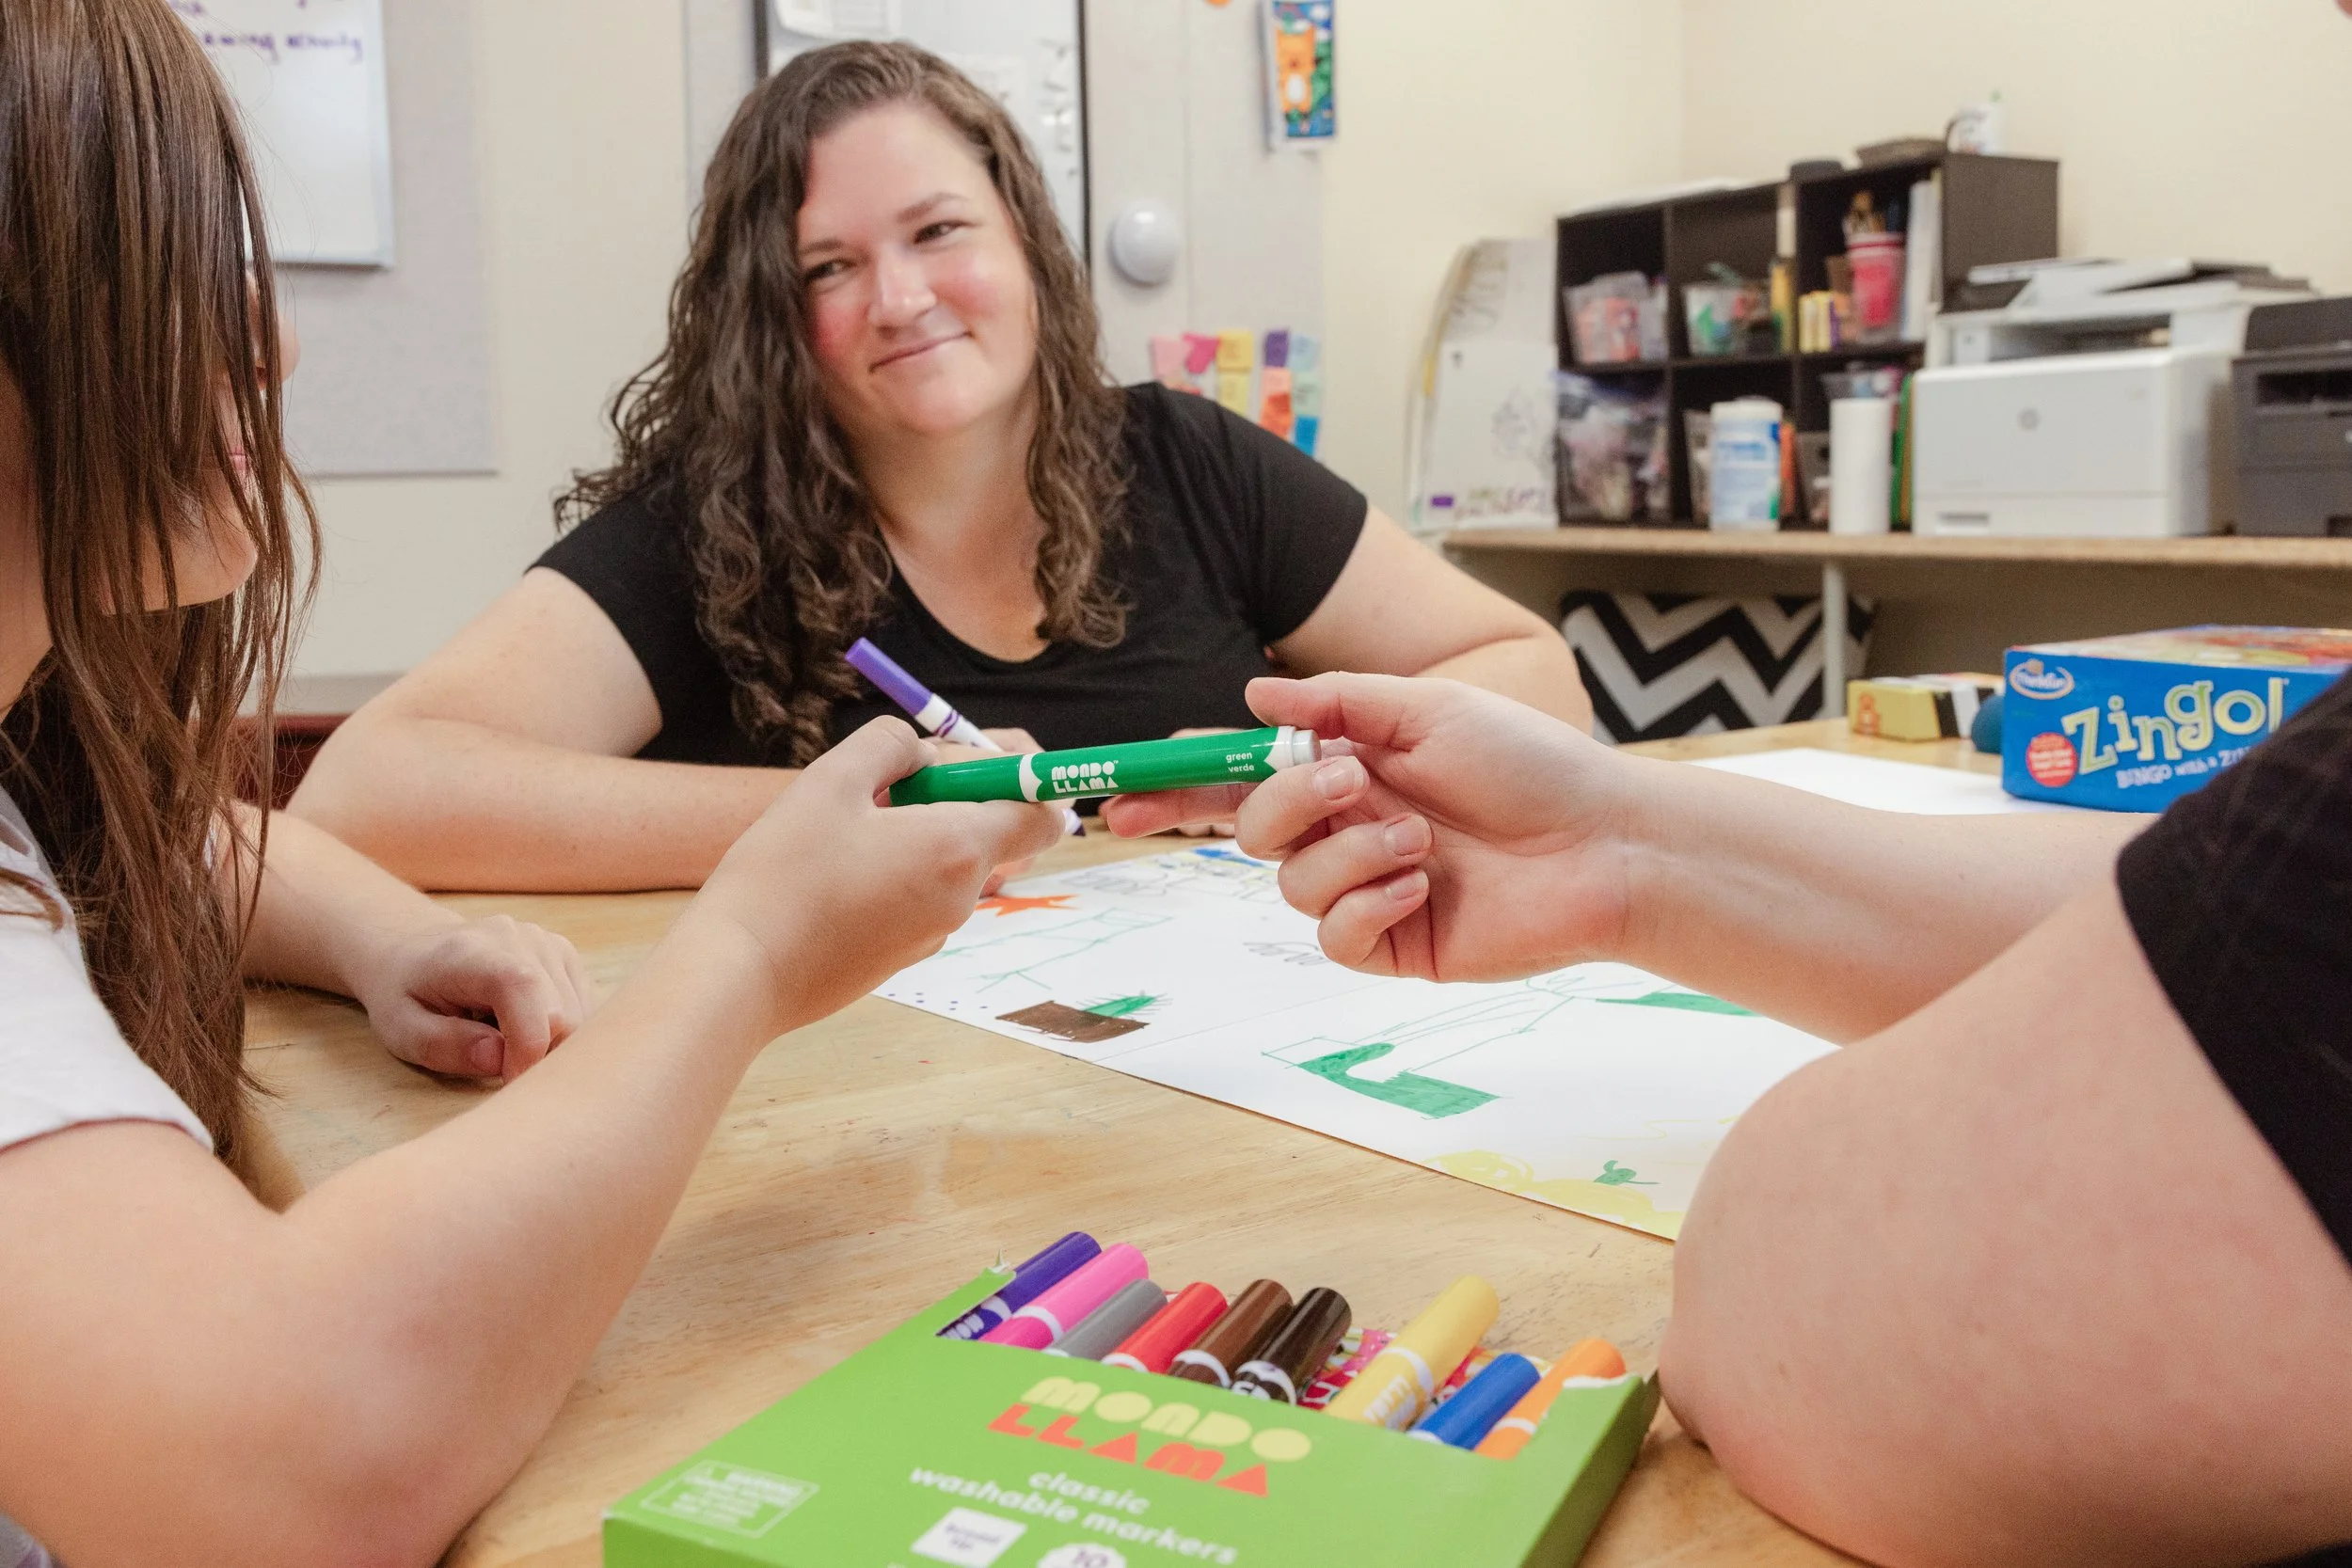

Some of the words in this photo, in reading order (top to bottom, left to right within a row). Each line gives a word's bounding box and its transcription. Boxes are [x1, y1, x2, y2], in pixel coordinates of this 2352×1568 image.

[1226, 752, 1252, 764] green
[1228, 763, 1254, 773] verde
[1053, 776, 1119, 794] LLAMA
[2116, 764, 2172, 788] BINGO
[1021, 1376, 1311, 1462] MONDO
[986, 1402, 1268, 1497] LLAMA
[1029, 1471, 1151, 1515] classic
[909, 1466, 1079, 1523] washable
[1082, 1512, 1238, 1565] markers
